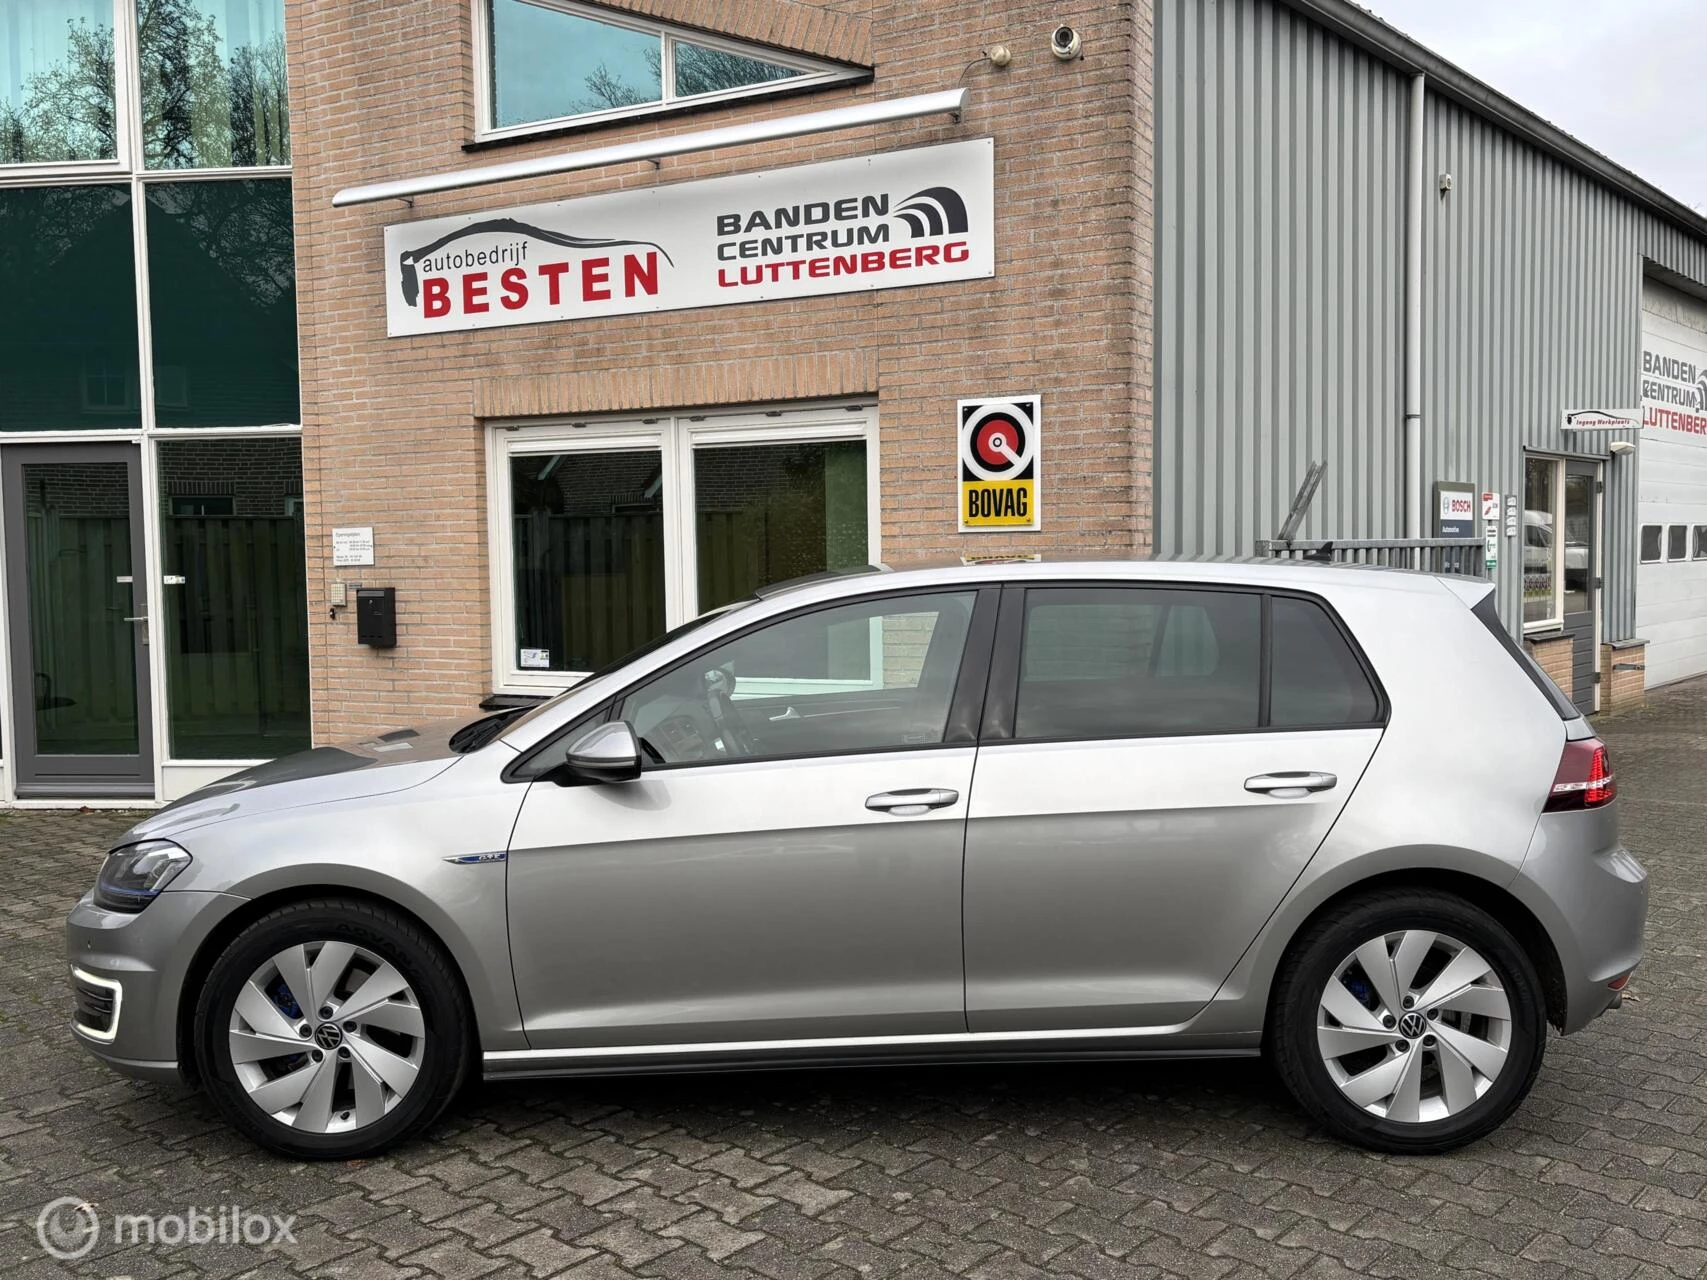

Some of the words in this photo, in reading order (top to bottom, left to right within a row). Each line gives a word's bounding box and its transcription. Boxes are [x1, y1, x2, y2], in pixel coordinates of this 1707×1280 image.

[716, 193, 890, 237] BANDEN
[422, 240, 529, 273] autobedrijf
[716, 223, 890, 261] CENTRUM
[717, 241, 970, 288] LUTTENBERG
[422, 251, 659, 319] BESTEN
[1642, 350, 1696, 385] BANDEN
[1642, 379, 1697, 409] CENTRUM
[968, 487, 1028, 518] BOVAG
[1451, 499, 1471, 513] BOSCH
